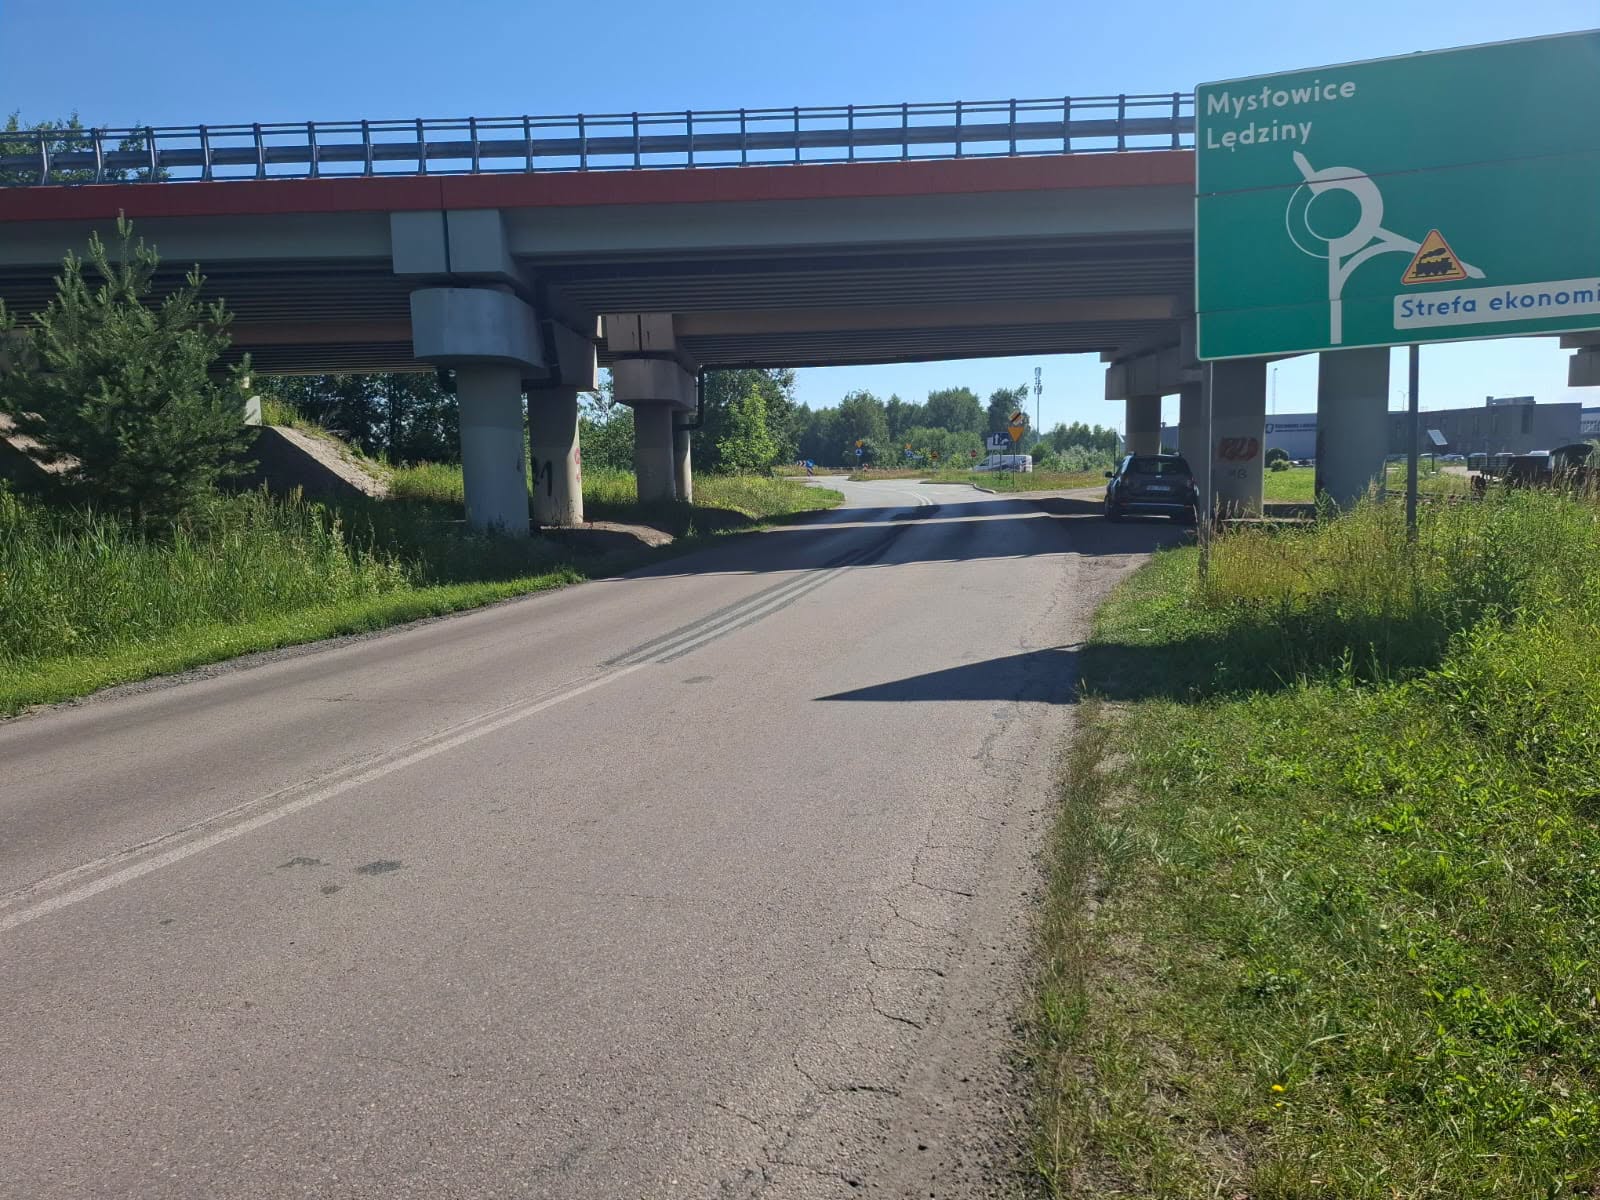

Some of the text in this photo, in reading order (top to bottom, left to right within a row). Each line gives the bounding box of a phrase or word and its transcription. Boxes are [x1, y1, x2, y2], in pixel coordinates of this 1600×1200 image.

[1207, 80, 1357, 116] Mysłowice
[1207, 120, 1312, 151] Lędziny
[1400, 296, 1477, 318] Strefa
